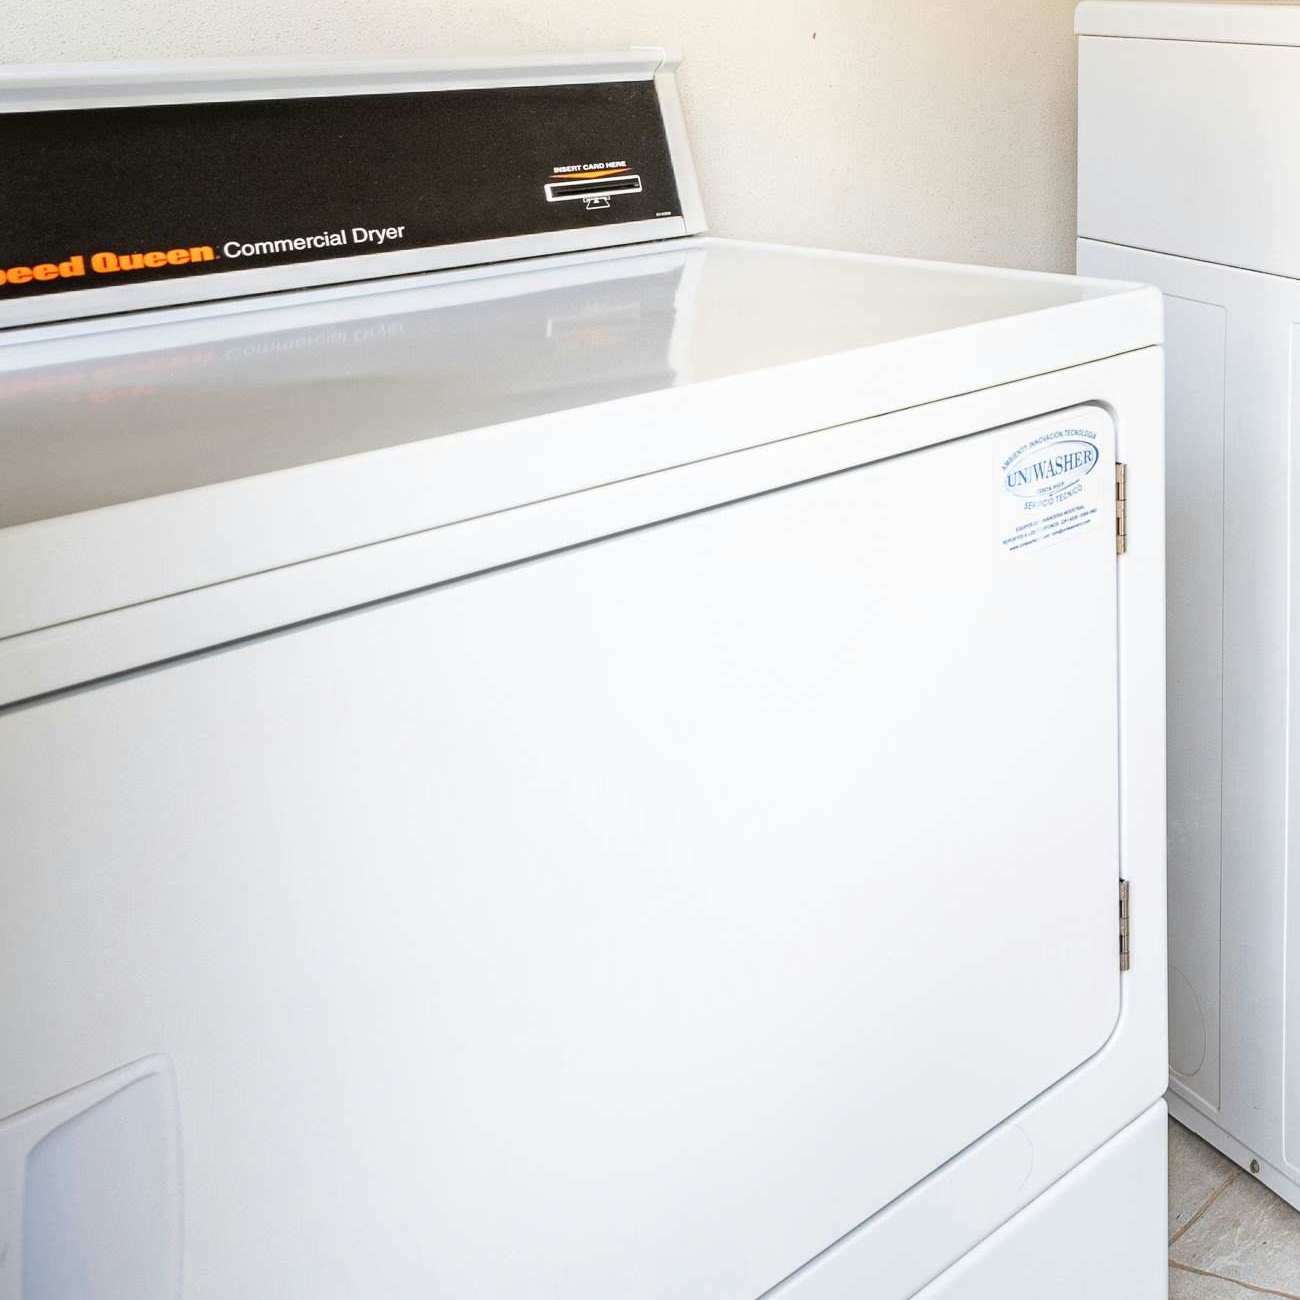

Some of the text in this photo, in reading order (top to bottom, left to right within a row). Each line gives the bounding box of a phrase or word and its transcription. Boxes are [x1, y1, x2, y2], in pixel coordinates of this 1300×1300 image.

[553, 160, 627, 174] INSERT CARD HERE
[91, 245, 215, 273] Queen
[223, 229, 348, 259] Commercial
[352, 225, 405, 245] Dryer
